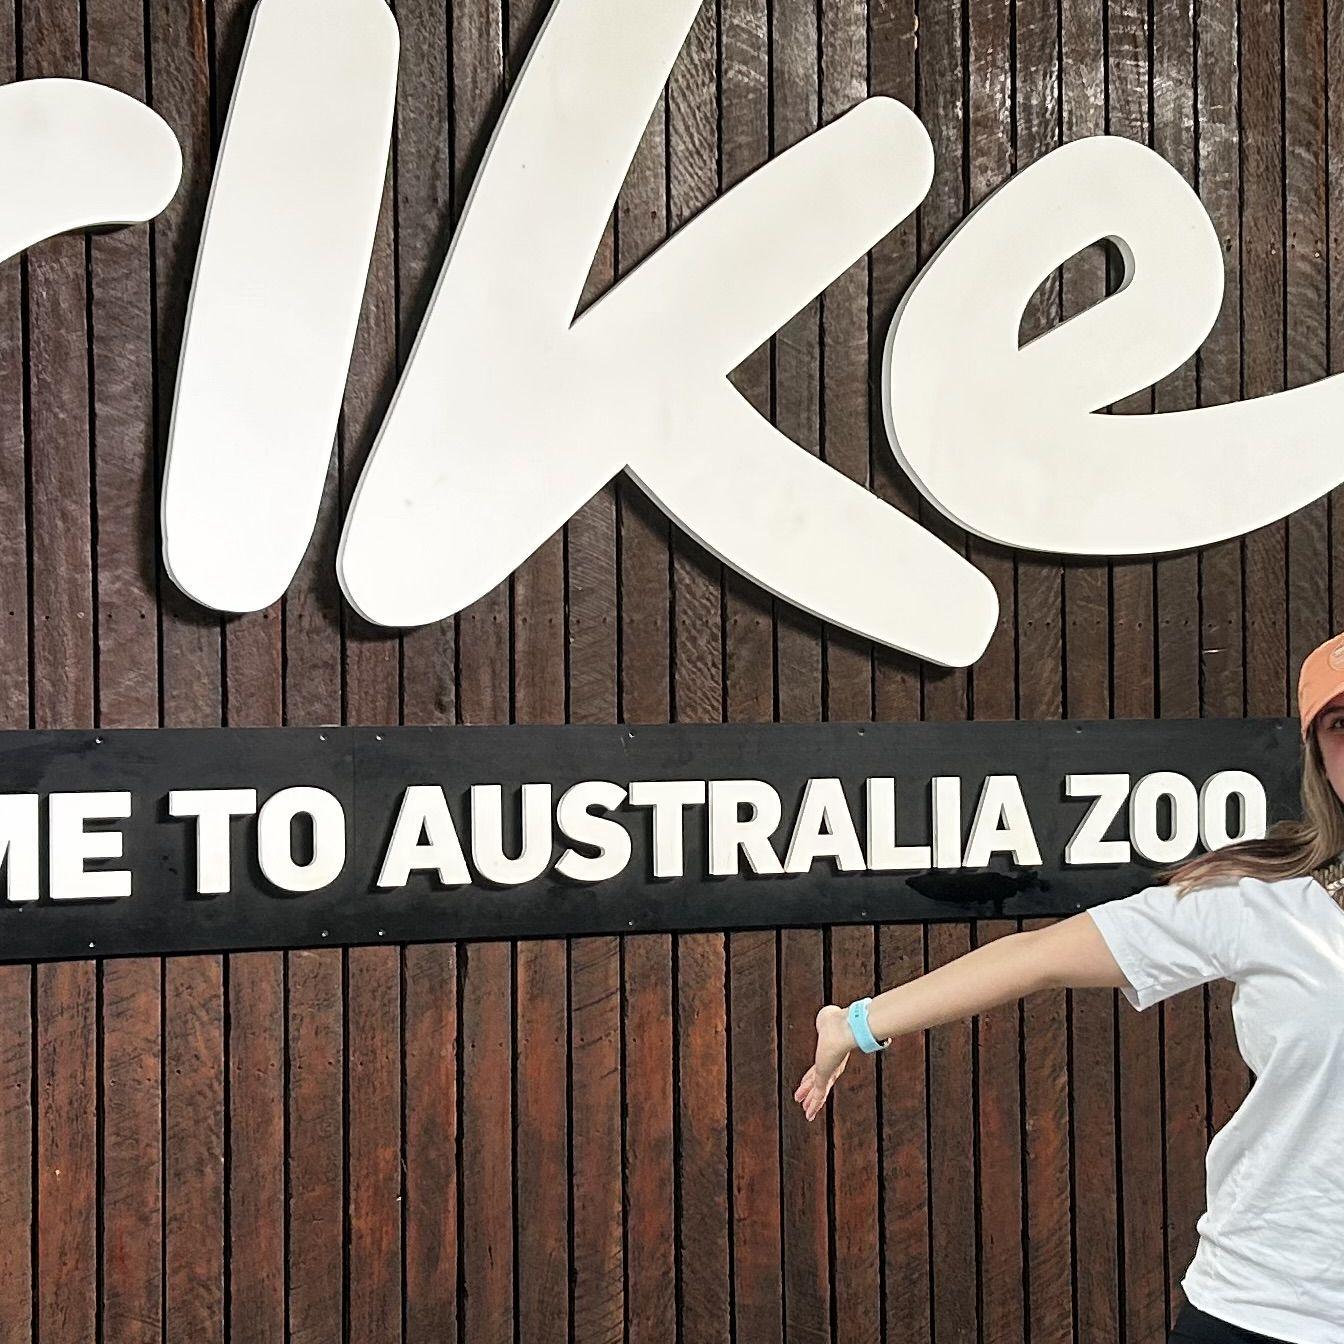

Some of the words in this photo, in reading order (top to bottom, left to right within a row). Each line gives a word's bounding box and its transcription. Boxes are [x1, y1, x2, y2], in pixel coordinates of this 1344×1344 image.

[167, 786, 347, 894] TO
[375, 775, 1043, 890] AUSTRALIA
[1064, 770, 1267, 865] ZOO
